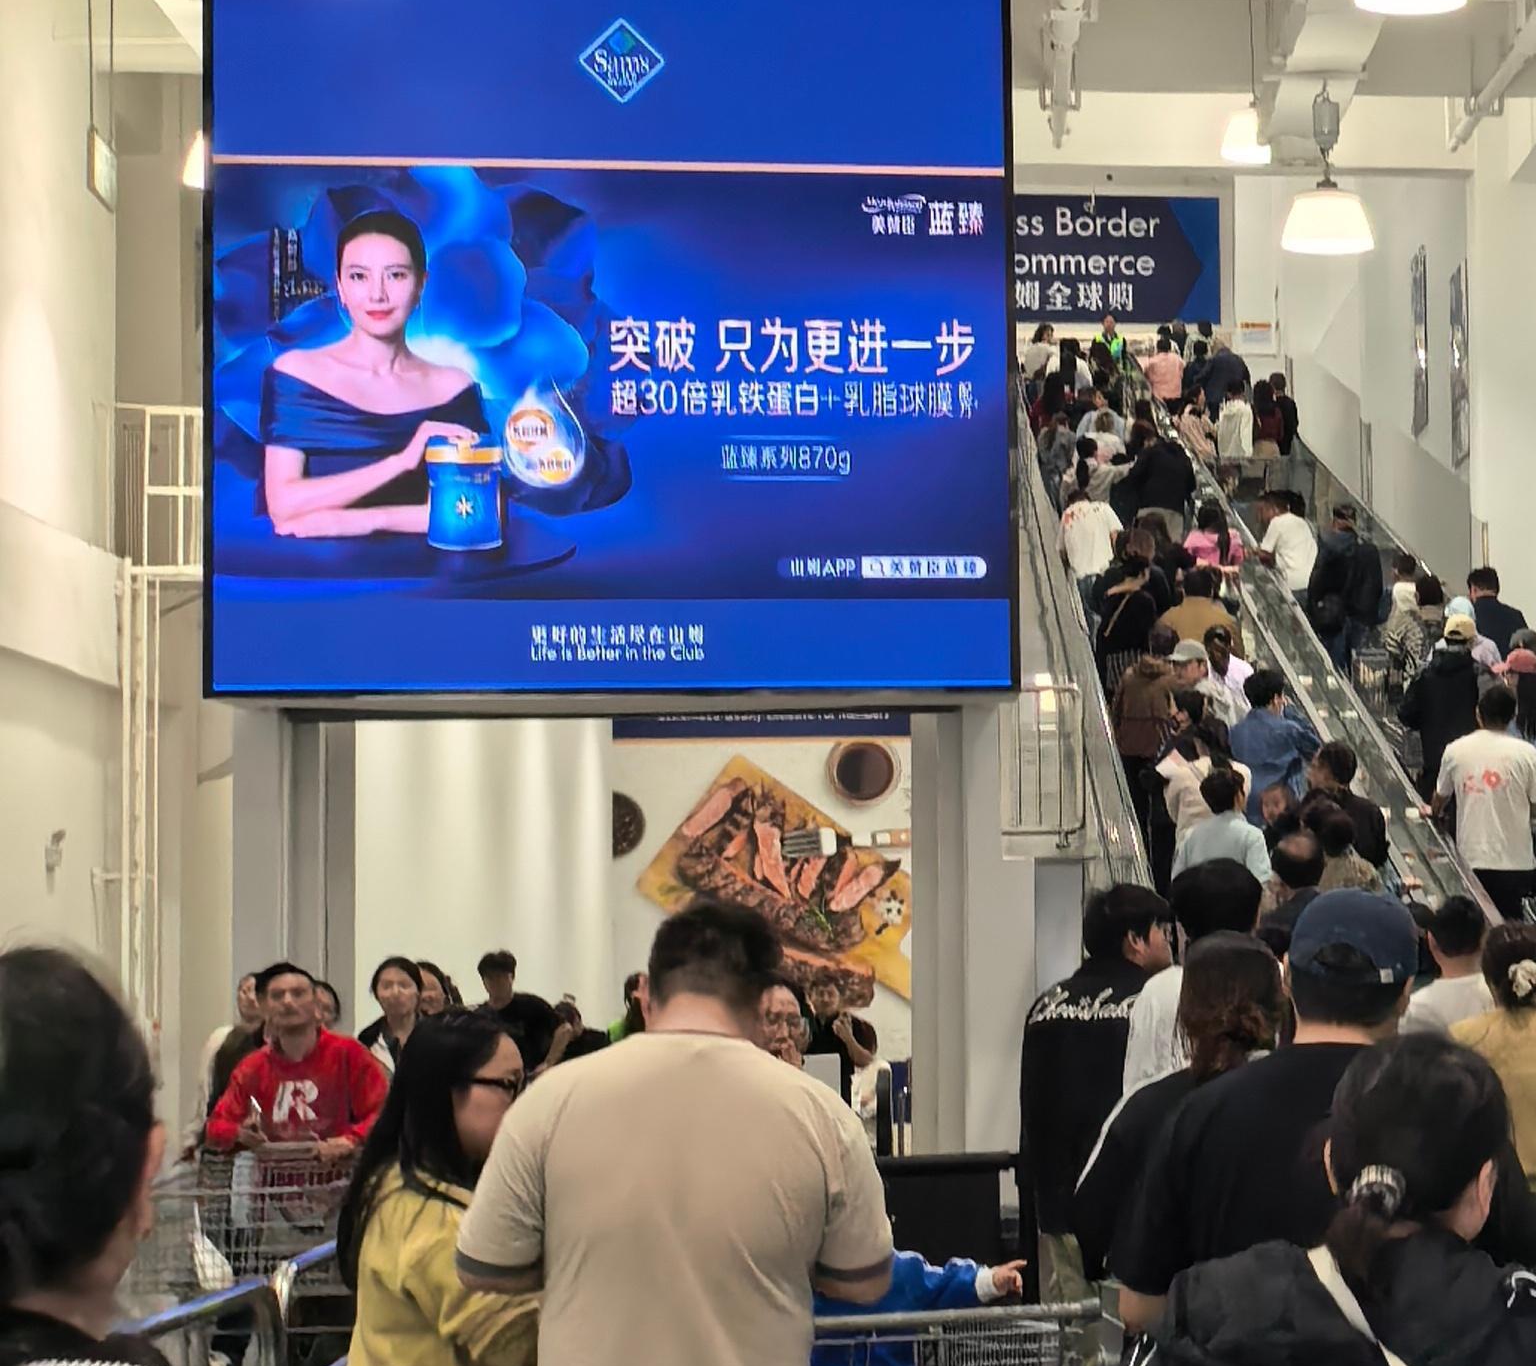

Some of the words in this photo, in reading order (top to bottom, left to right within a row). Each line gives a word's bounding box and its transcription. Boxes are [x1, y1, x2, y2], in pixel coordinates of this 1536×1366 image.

[1056, 206, 1161, 239] Border
[1015, 252, 1156, 277] ommerce
[609, 316, 696, 373] 突破
[715, 316, 976, 376] 只为更进一步
